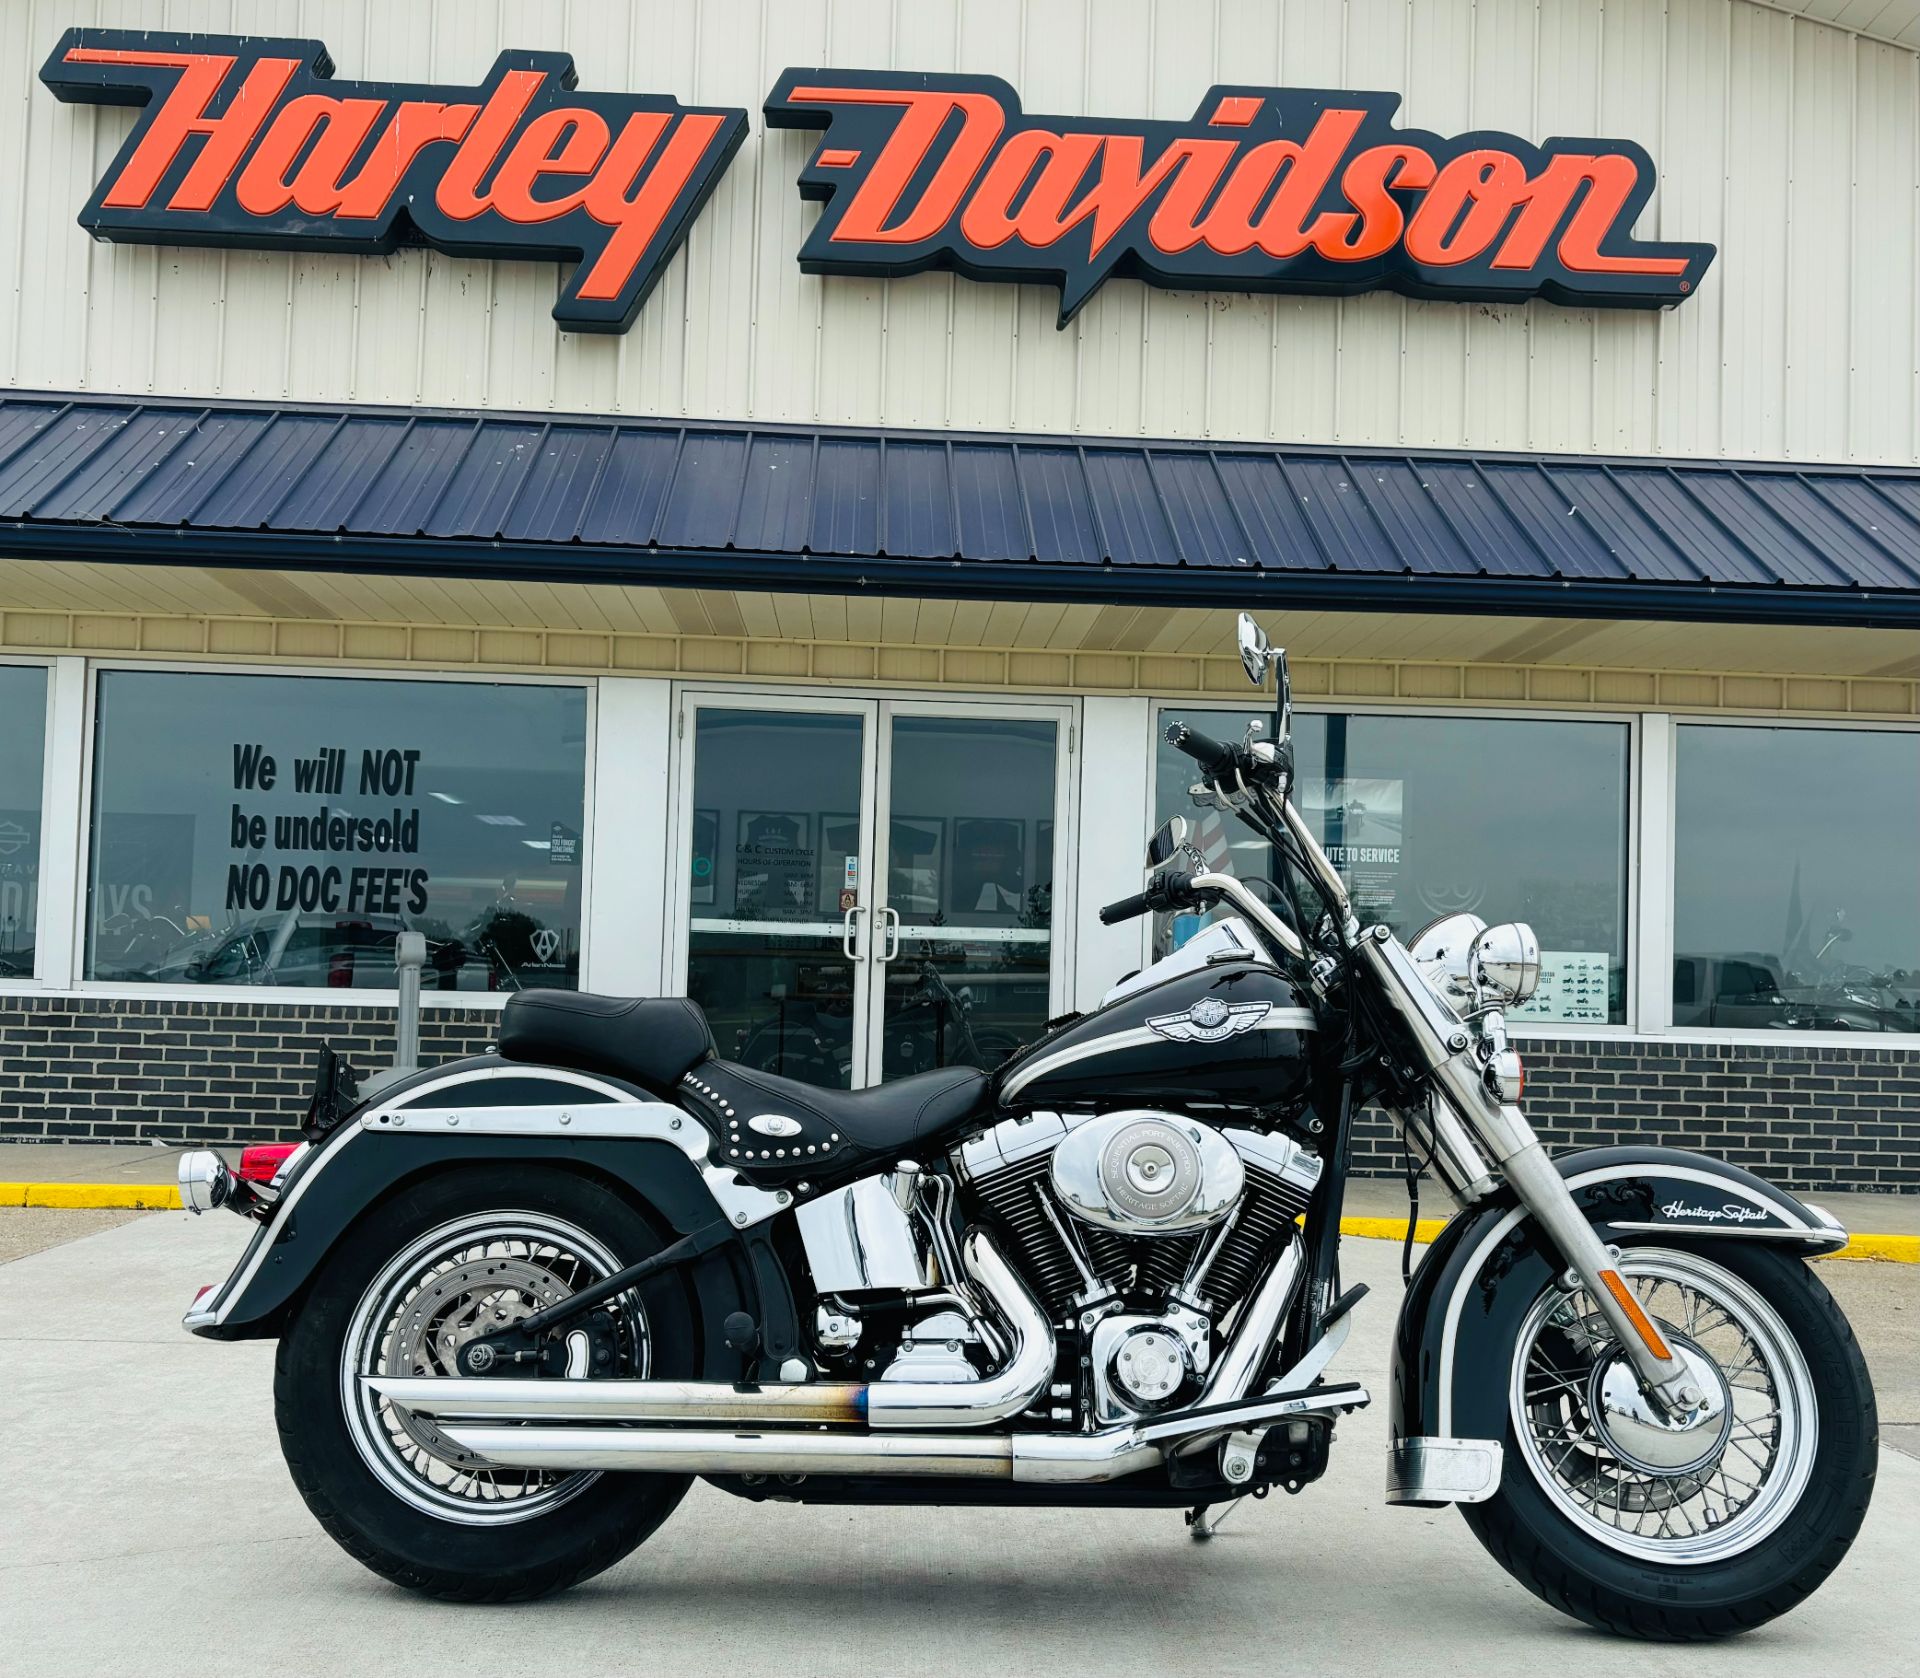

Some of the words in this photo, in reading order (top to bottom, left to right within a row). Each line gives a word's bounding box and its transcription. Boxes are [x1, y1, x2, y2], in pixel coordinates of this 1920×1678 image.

[61, 48, 726, 300] Harley
[233, 744, 276, 791] We
[294, 747, 345, 794] will
[360, 749, 420, 796] NOT
[231, 804, 267, 850] be
[275, 806, 419, 853] undersold
[764, 847, 794, 856] CUSTOM
[1321, 846, 1344, 861] UTE
[1346, 847, 1358, 862] TO
[1360, 848, 1400, 863] SERVICE
[226, 864, 270, 910] NO
[276, 865, 343, 912] DOC
[347, 867, 429, 914] FEE'S
[1111, 1132, 1141, 1179] SEQUENTIAL
[1142, 1129, 1166, 1138] PORT
[1166, 1136, 1192, 1176] INJECTION
[1116, 1185, 1158, 1211] HERITAGE
[1159, 1182, 1189, 1209] SOFTAIL
[1661, 1199, 1722, 1222] Heritage
[1722, 1204, 1768, 1223] Softail
